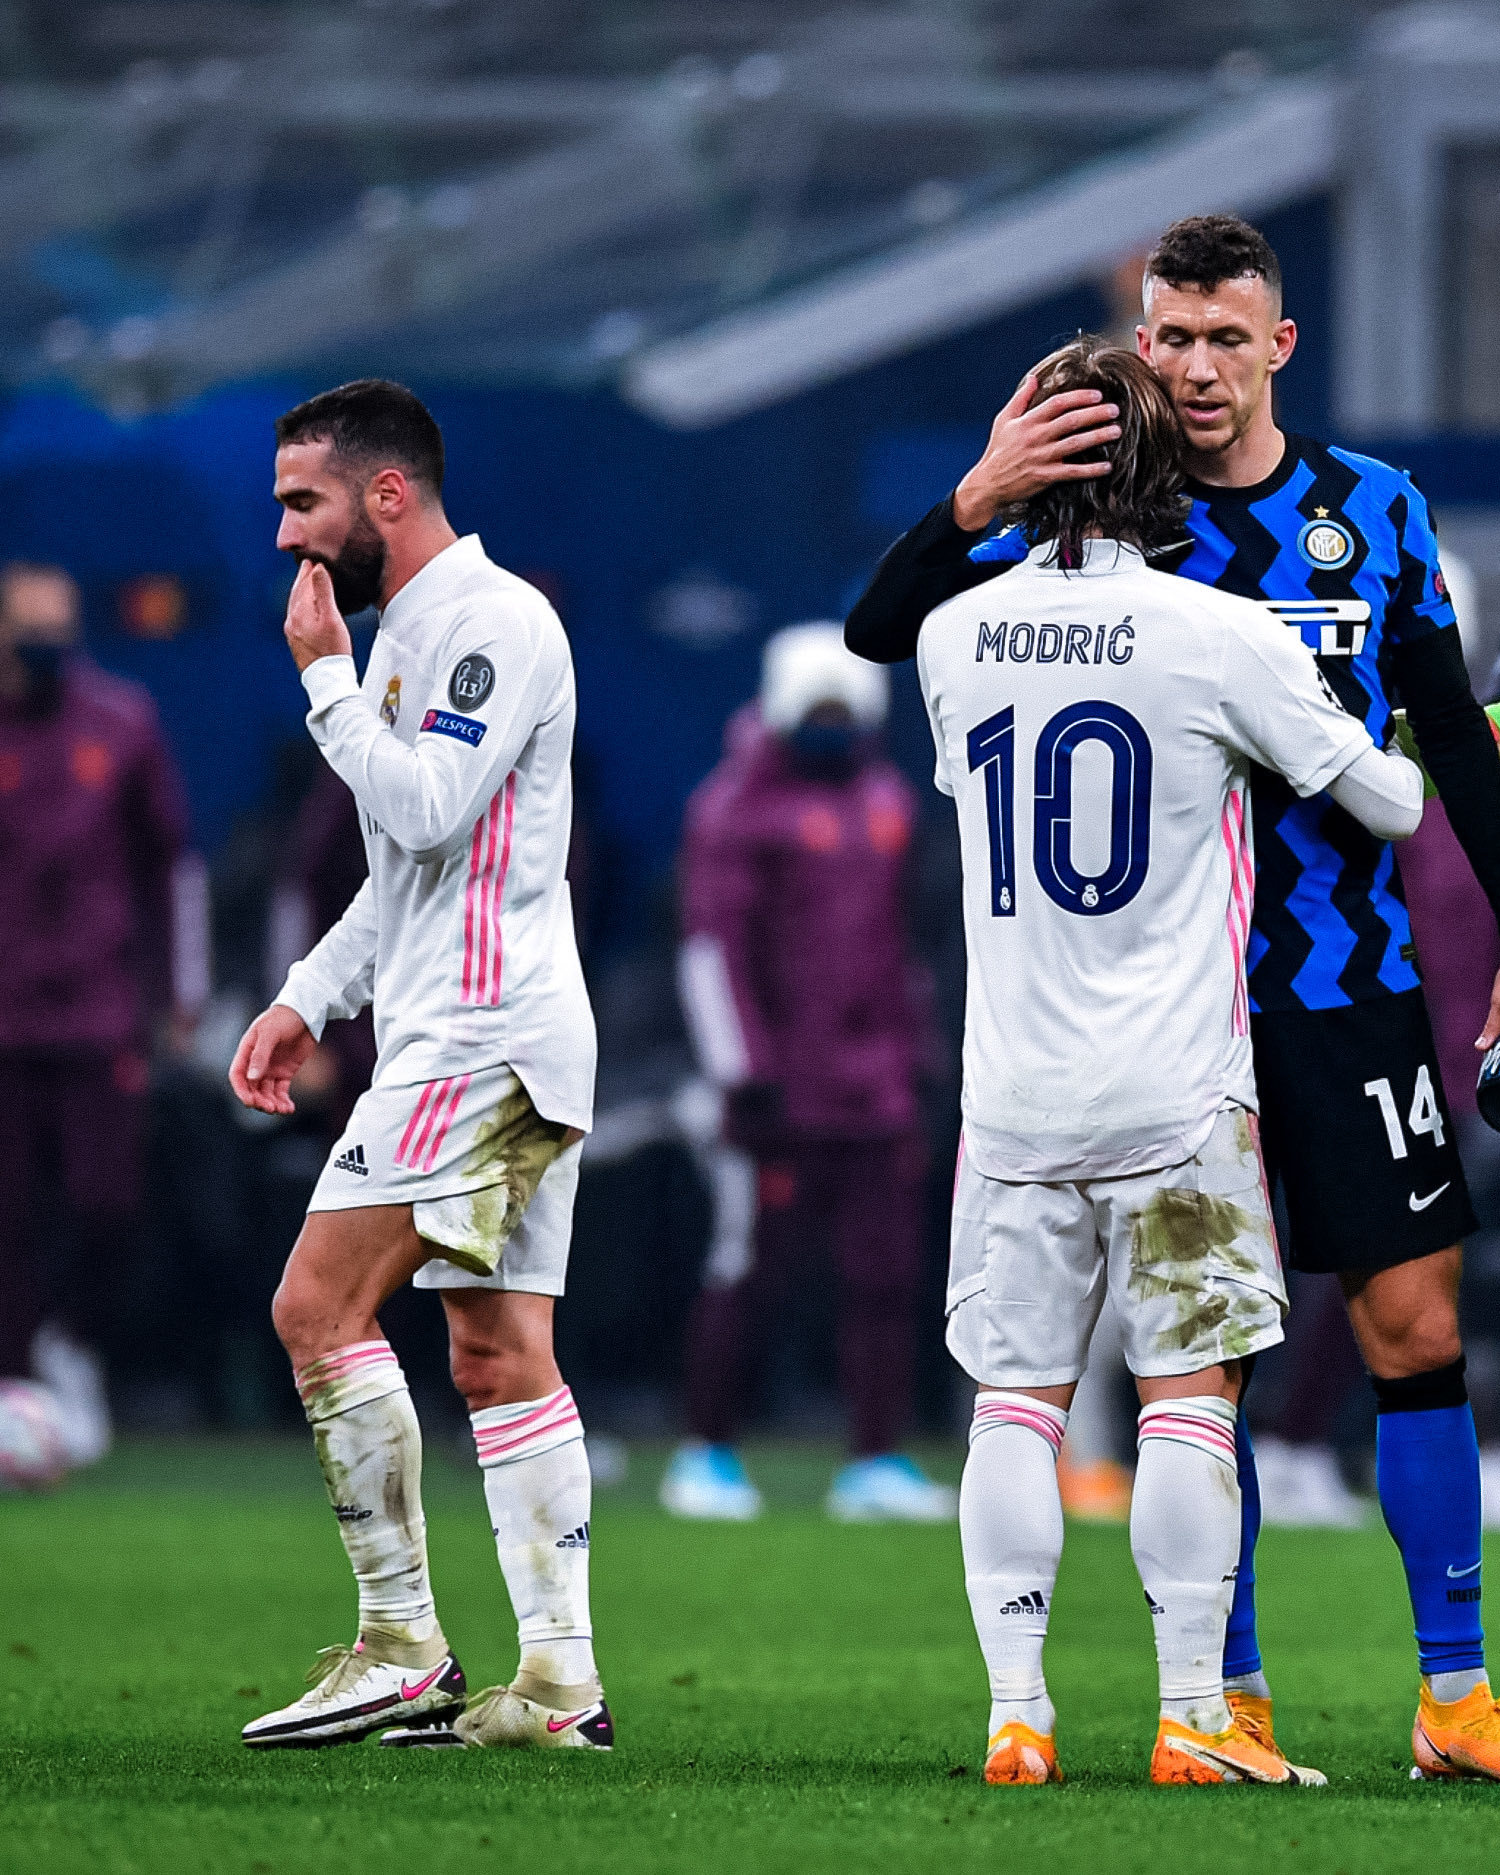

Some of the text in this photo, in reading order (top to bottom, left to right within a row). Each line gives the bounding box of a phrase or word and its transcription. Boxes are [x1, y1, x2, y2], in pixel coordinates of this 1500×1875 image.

[975, 615, 1136, 666] MODRIĆ
[459, 680, 478, 698] 13
[435, 717, 484, 741] RESPECT
[966, 699, 1154, 917] 10
[1364, 1064, 1446, 1160] 14
[333, 1159, 369, 1176] adidas
